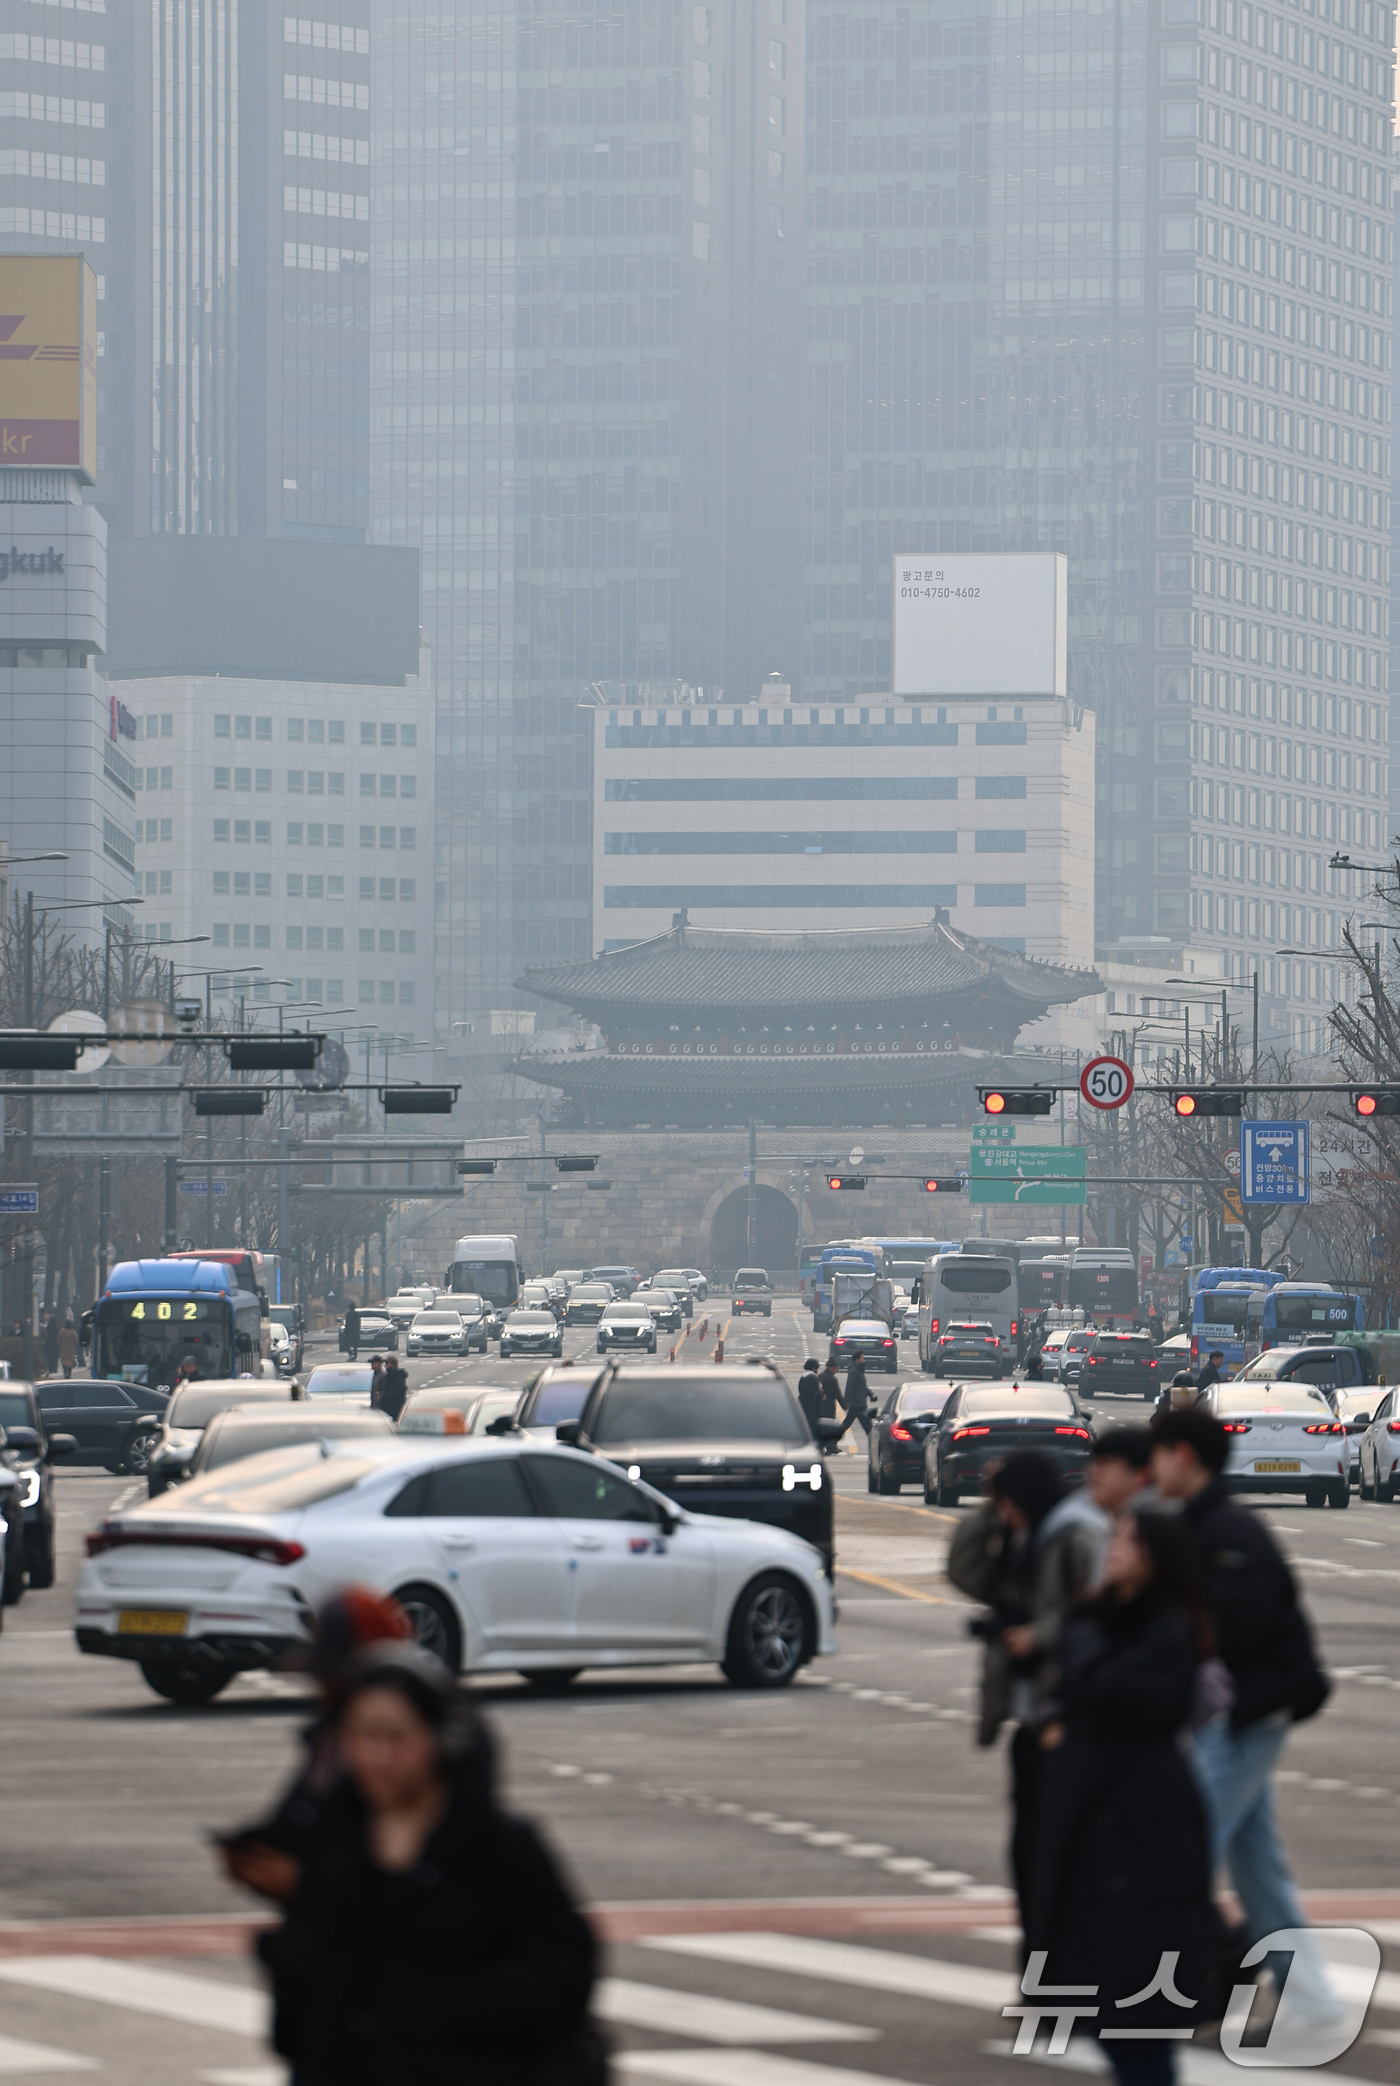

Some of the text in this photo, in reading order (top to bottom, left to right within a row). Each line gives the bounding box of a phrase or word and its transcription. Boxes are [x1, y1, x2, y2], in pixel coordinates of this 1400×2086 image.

[3, 427, 32, 453] kr
[903, 571, 944, 582] 광고문의
[901, 588, 981, 598] 010-4750-4602
[1092, 1070, 1123, 1097] 50
[979, 1128, 1010, 1137] 숭례문
[1320, 1139, 1372, 1154] 24시간
[1256, 1164, 1294, 1173] 전방300m
[1256, 1174, 1294, 1183] 중앙차로
[1255, 1185, 1294, 1193] 버스전용
[1329, 1308, 1347, 1320] 500
